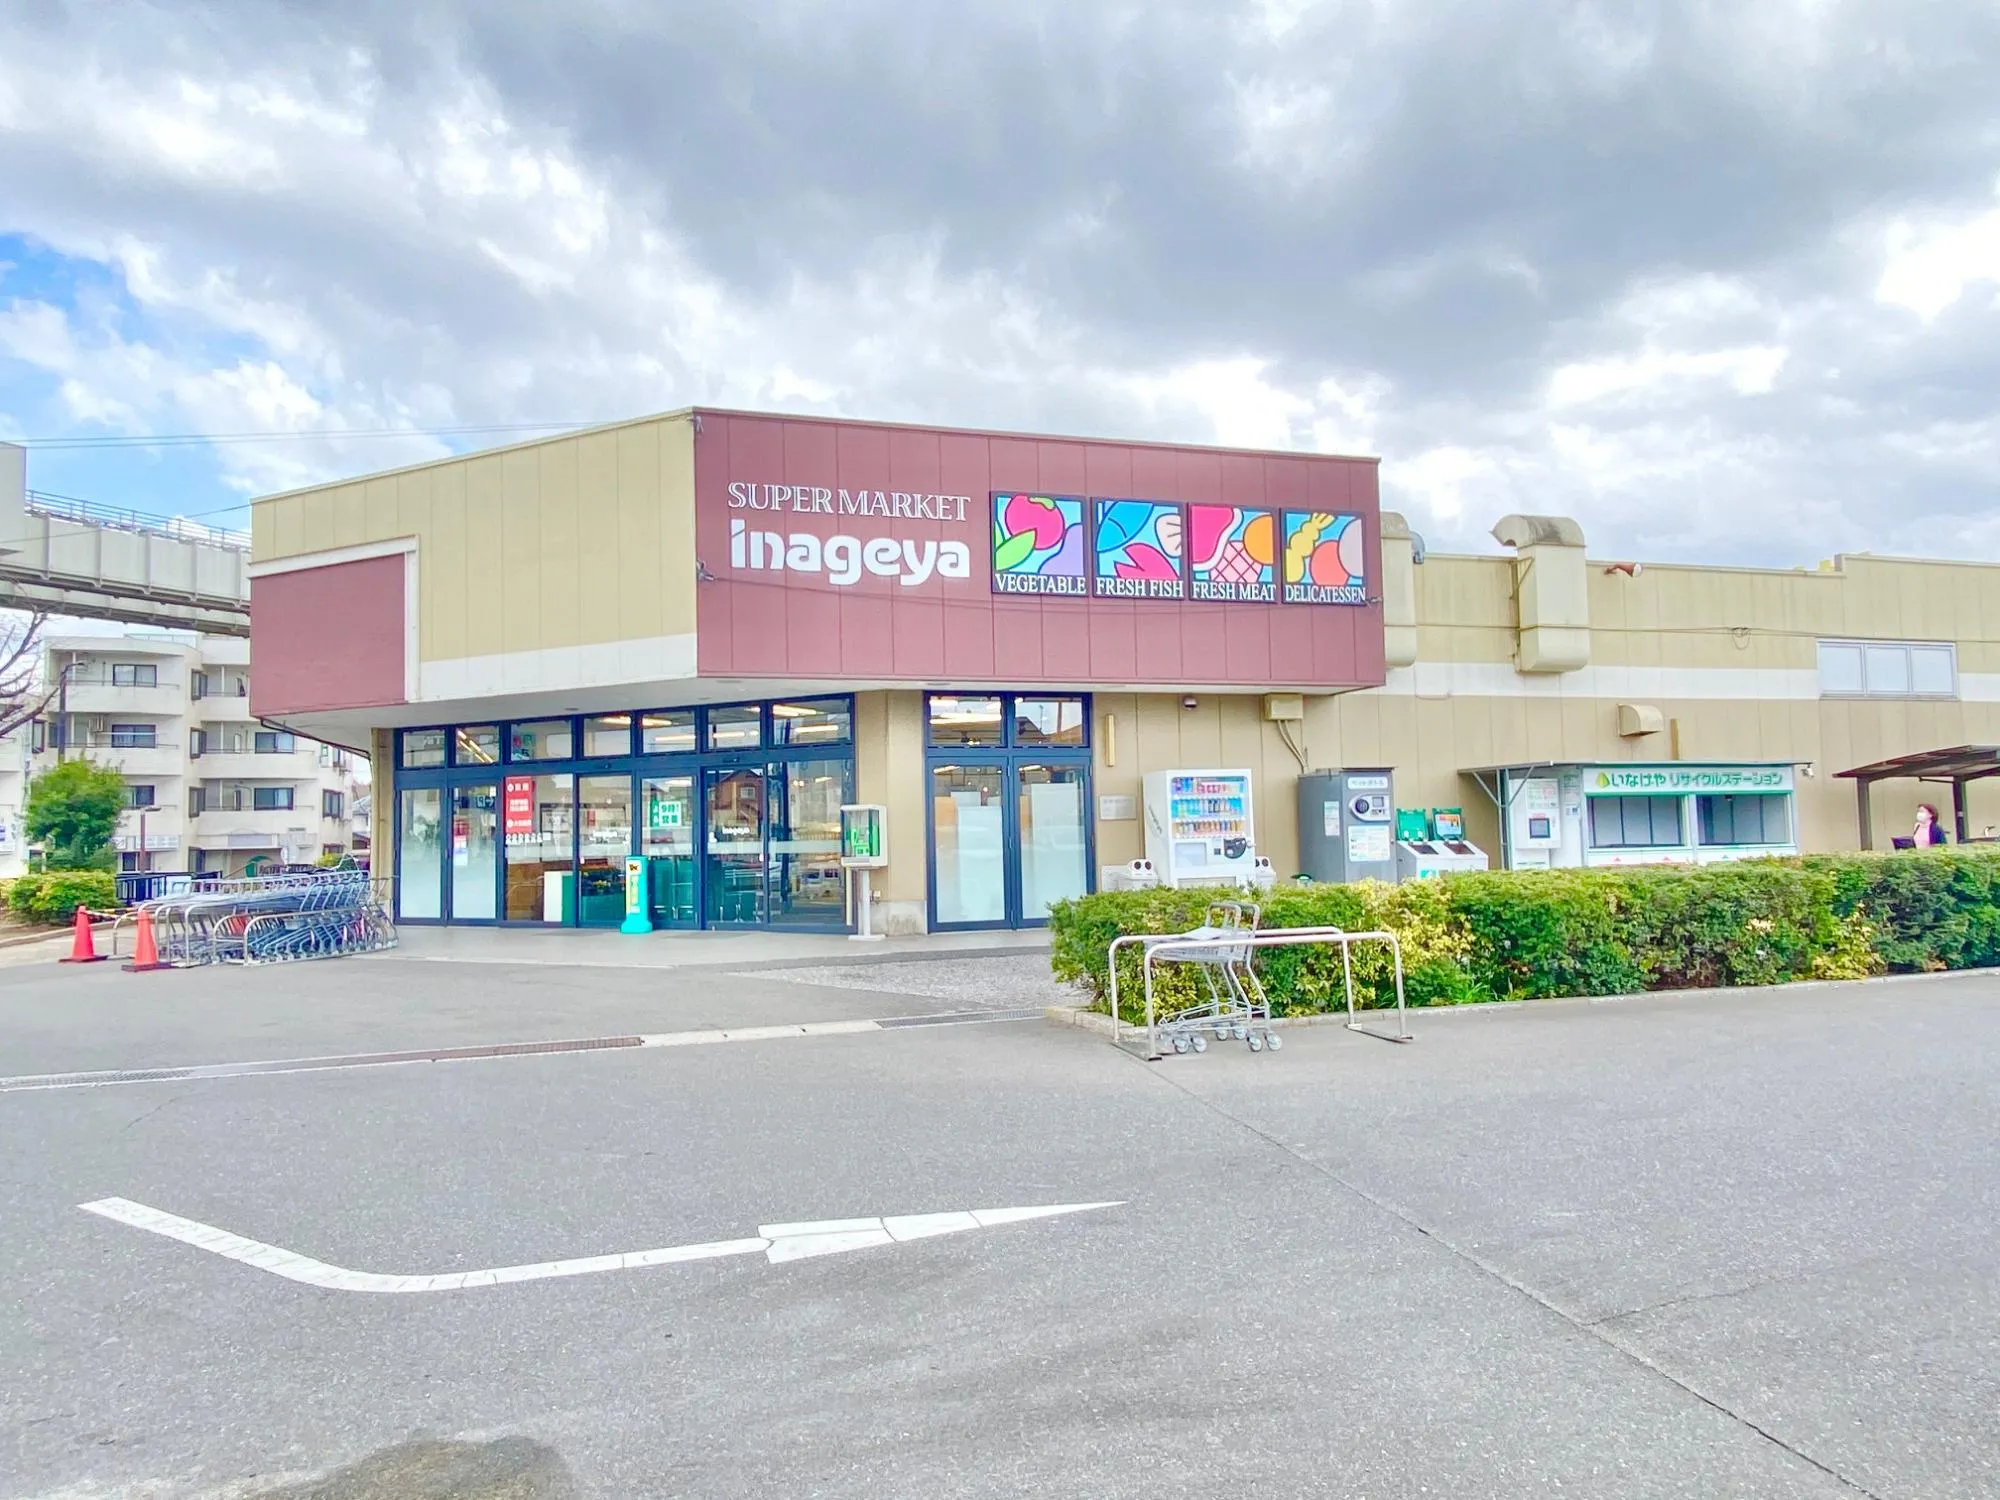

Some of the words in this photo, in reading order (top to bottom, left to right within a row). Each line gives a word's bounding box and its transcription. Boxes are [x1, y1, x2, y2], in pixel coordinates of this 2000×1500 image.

[727, 482, 834, 515] SUPER
[838, 488, 971, 522] MARKET
[994, 573, 1087, 595] VEGETABLE
[1095, 576, 1146, 597] FRESH
[1149, 579, 1185, 598] FISH
[1192, 581, 1237, 600] FRESH
[1238, 582, 1277, 602] MEAT
[1285, 584, 1367, 603] DELICATESSEN
[1670, 771, 1783, 786] リサイクルステーション
